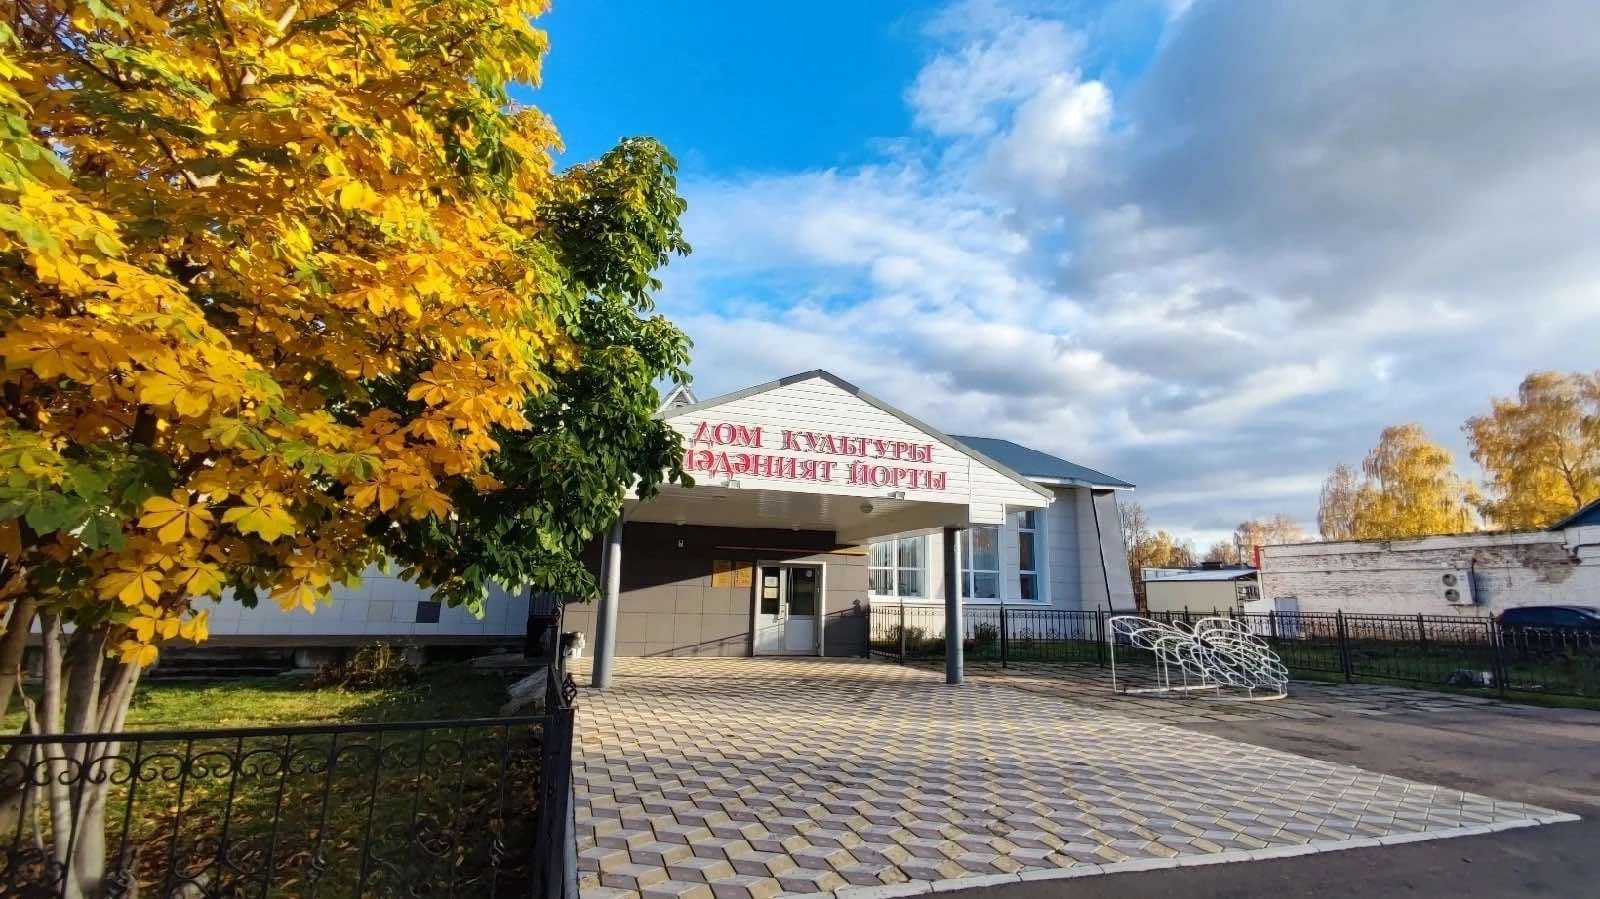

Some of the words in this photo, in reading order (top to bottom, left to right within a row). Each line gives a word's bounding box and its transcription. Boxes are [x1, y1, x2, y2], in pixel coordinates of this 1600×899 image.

[692, 421, 764, 449] ДОМ
[782, 429, 934, 464] КУЛЬТУРЫ
[848, 459, 948, 491] ЙОРТЫ
